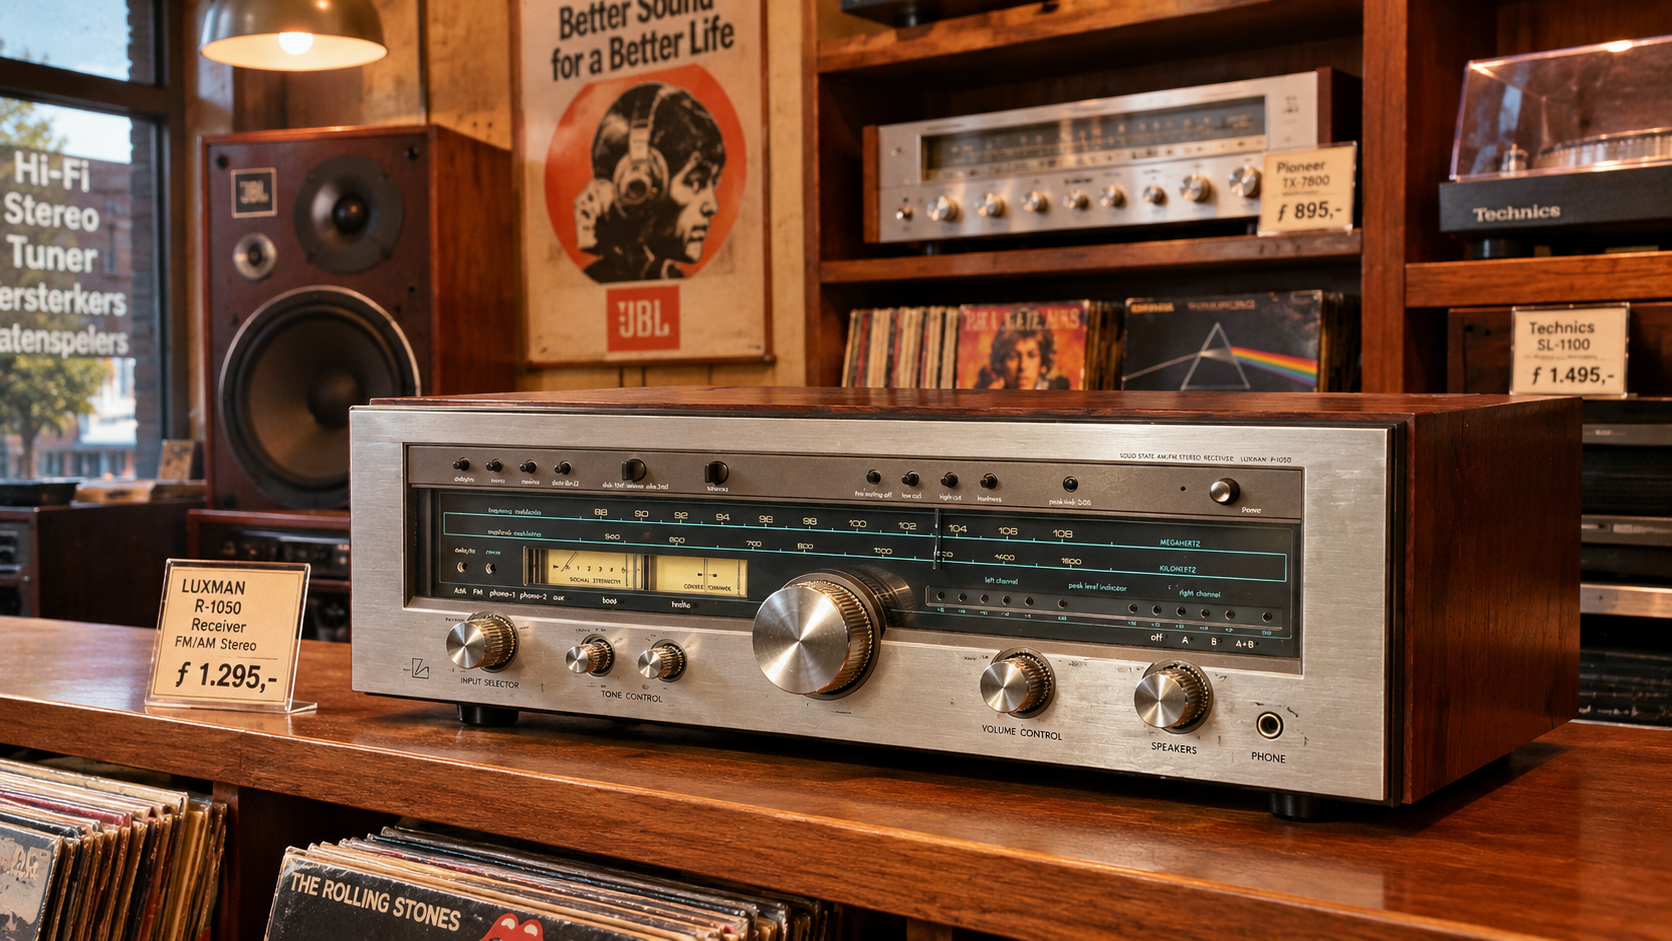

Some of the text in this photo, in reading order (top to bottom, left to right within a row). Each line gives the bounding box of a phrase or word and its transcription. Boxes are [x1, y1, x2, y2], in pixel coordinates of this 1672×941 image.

[560, 1, 631, 40] Better
[551, 15, 734, 82] for a Better Life
[14, 151, 90, 193] Hi-Fi
[1277, 162, 1326, 173] Pioneer
[1283, 175, 1330, 188] TX-7800
[4, 192, 100, 233] Stereo
[1295, 201, 1342, 219] 895,-
[1473, 204, 1561, 222] Technics
[6, 234, 98, 273] Tuner
[617, 298, 670, 338] JBL
[1530, 320, 1595, 334] Technics
[1538, 339, 1591, 351] SL-1100
[1550, 366, 1615, 385] 1.495,-
[634, 510, 649, 518] 90
[674, 511, 689, 520] 92
[716, 513, 731, 522] 94
[848, 519, 867, 529] 100
[898, 521, 917, 531] 102
[948, 524, 967, 534] 104
[998, 527, 1018, 536] 106
[1052, 529, 1073, 539] 108
[182, 579, 246, 595] LUXMAN
[195, 599, 242, 615] R-1050
[191, 618, 247, 633] Receiver
[175, 636, 257, 651] FM/AM Stereo
[1181, 636, 1189, 645] A
[1210, 637, 1218, 646] B
[1235, 639, 1254, 649] A+B
[199, 663, 278, 693] 1.295,-
[461, 677, 519, 689] INPUT SELECTOR
[601, 690, 663, 703] TONE CONTROL
[982, 725, 1062, 741] VOLUME CONTROL
[1151, 741, 1197, 755] SPEAKERS
[1251, 752, 1286, 764] PHONE
[292, 871, 462, 932] THE ROLLING STONES
